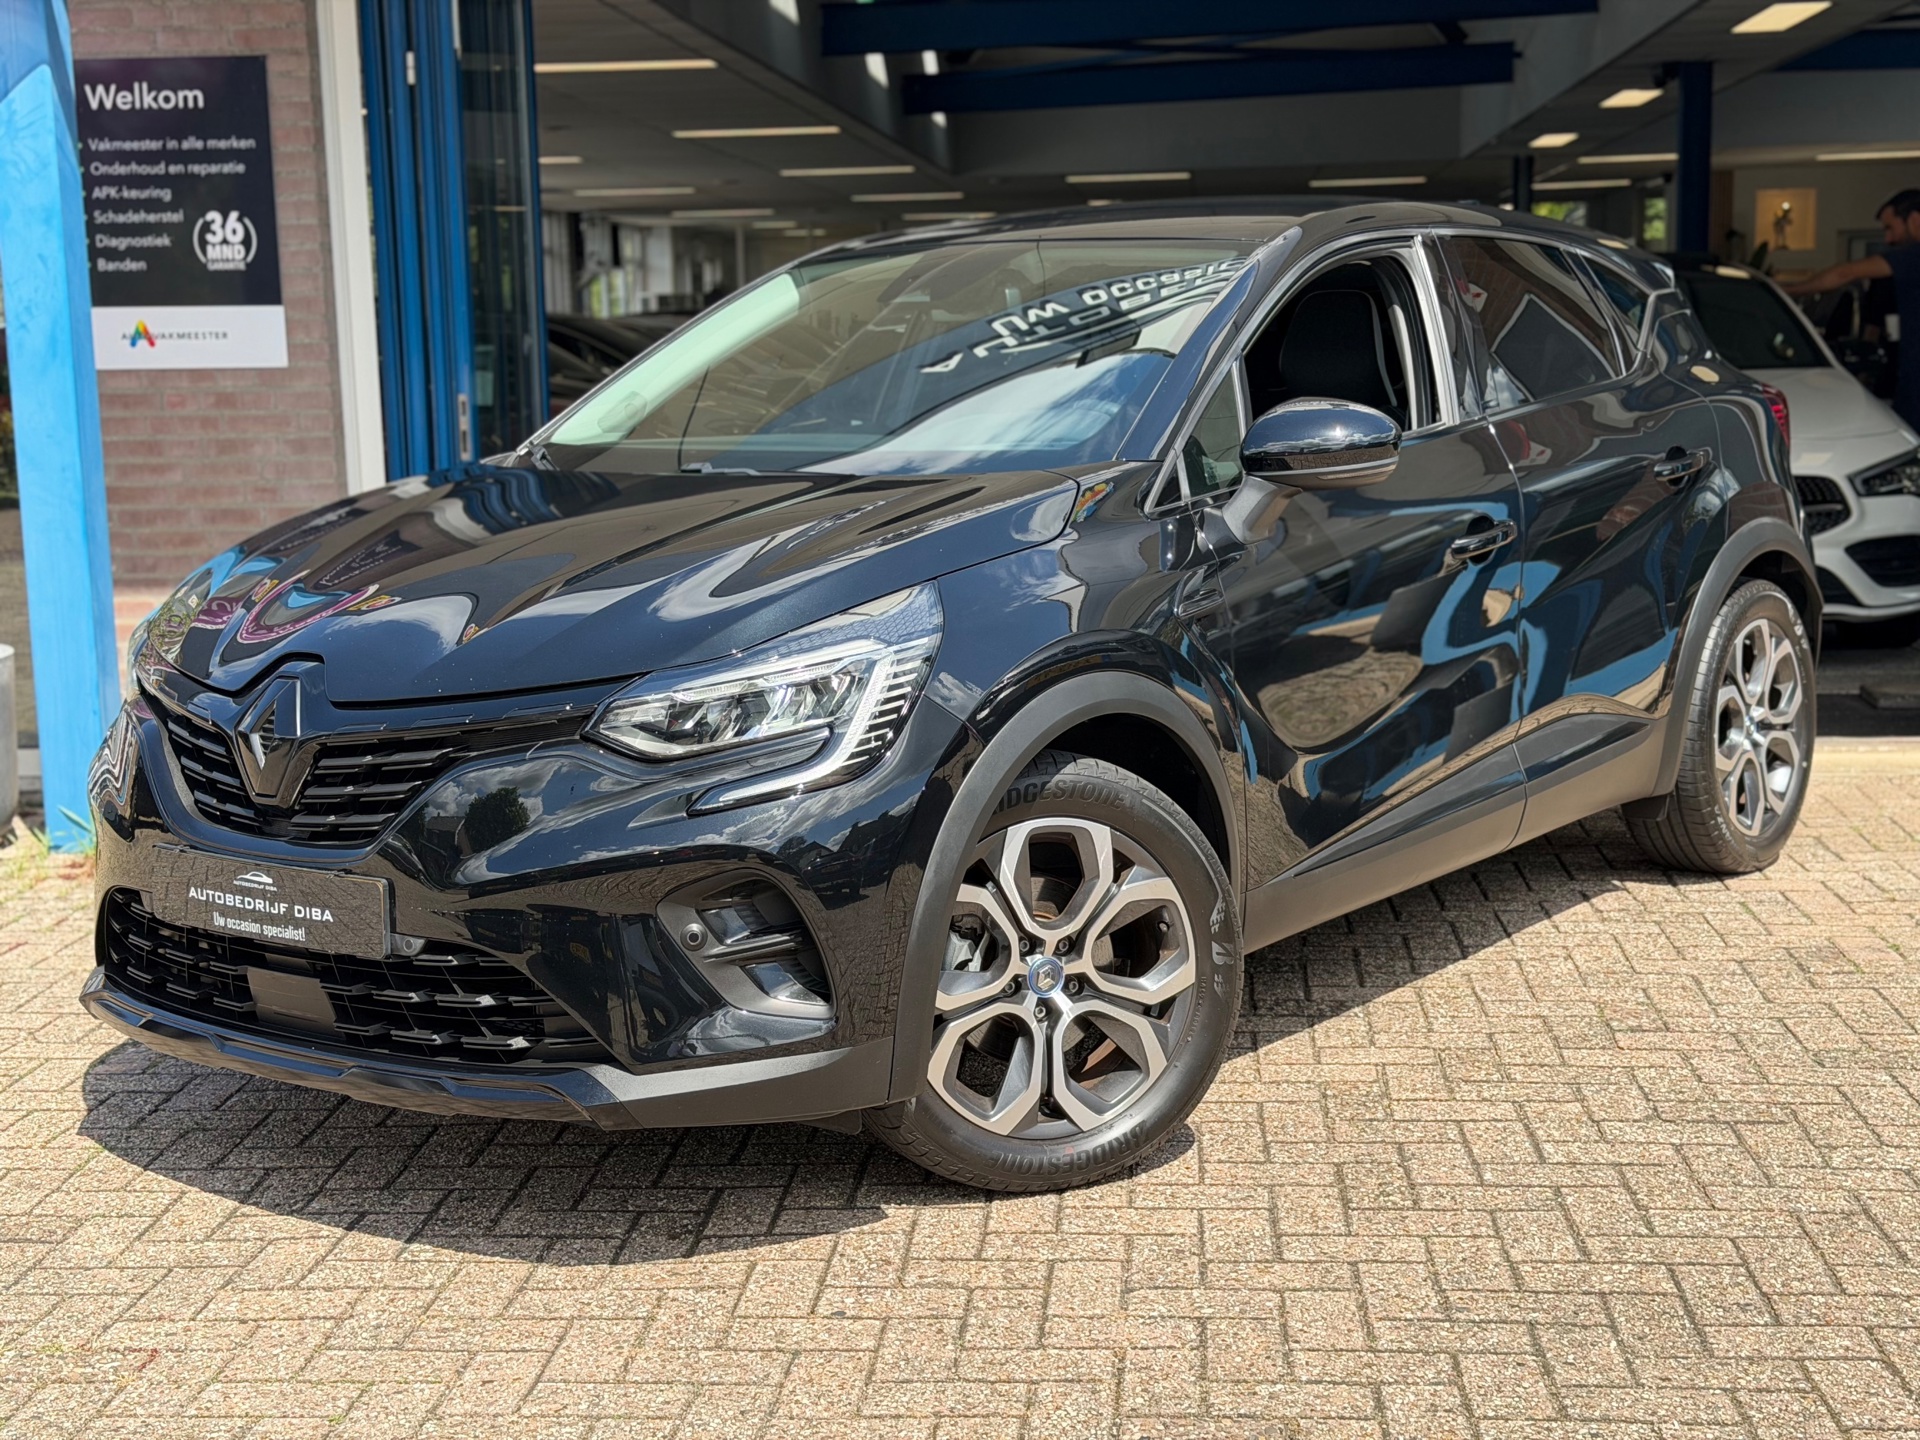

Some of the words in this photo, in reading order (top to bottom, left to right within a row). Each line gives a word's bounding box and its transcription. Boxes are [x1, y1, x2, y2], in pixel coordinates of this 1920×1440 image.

[84, 81, 205, 111] Welkom
[87, 137, 164, 152] Vakmeester
[165, 136, 180, 150] in
[181, 135, 205, 150] alle
[206, 135, 257, 150] merken
[89, 160, 166, 176] Onderhoud
[167, 163, 186, 175] en
[187, 160, 247, 178] reparatie
[91, 185, 173, 203] APK-keuring
[93, 208, 185, 225] Schadeherstel
[204, 210, 246, 244] 36
[94, 232, 172, 251] Diagnostiek
[205, 244, 246, 261] MND
[96, 257, 148, 272] Banden
[993, 779, 1129, 815] IDGESTONE
[188, 886, 289, 915] AUTOBEDRIJF
[294, 904, 334, 923] DIBA
[213, 911, 226, 927] Uw
[226, 918, 261, 934] occasion
[262, 923, 306, 941] specialist!
